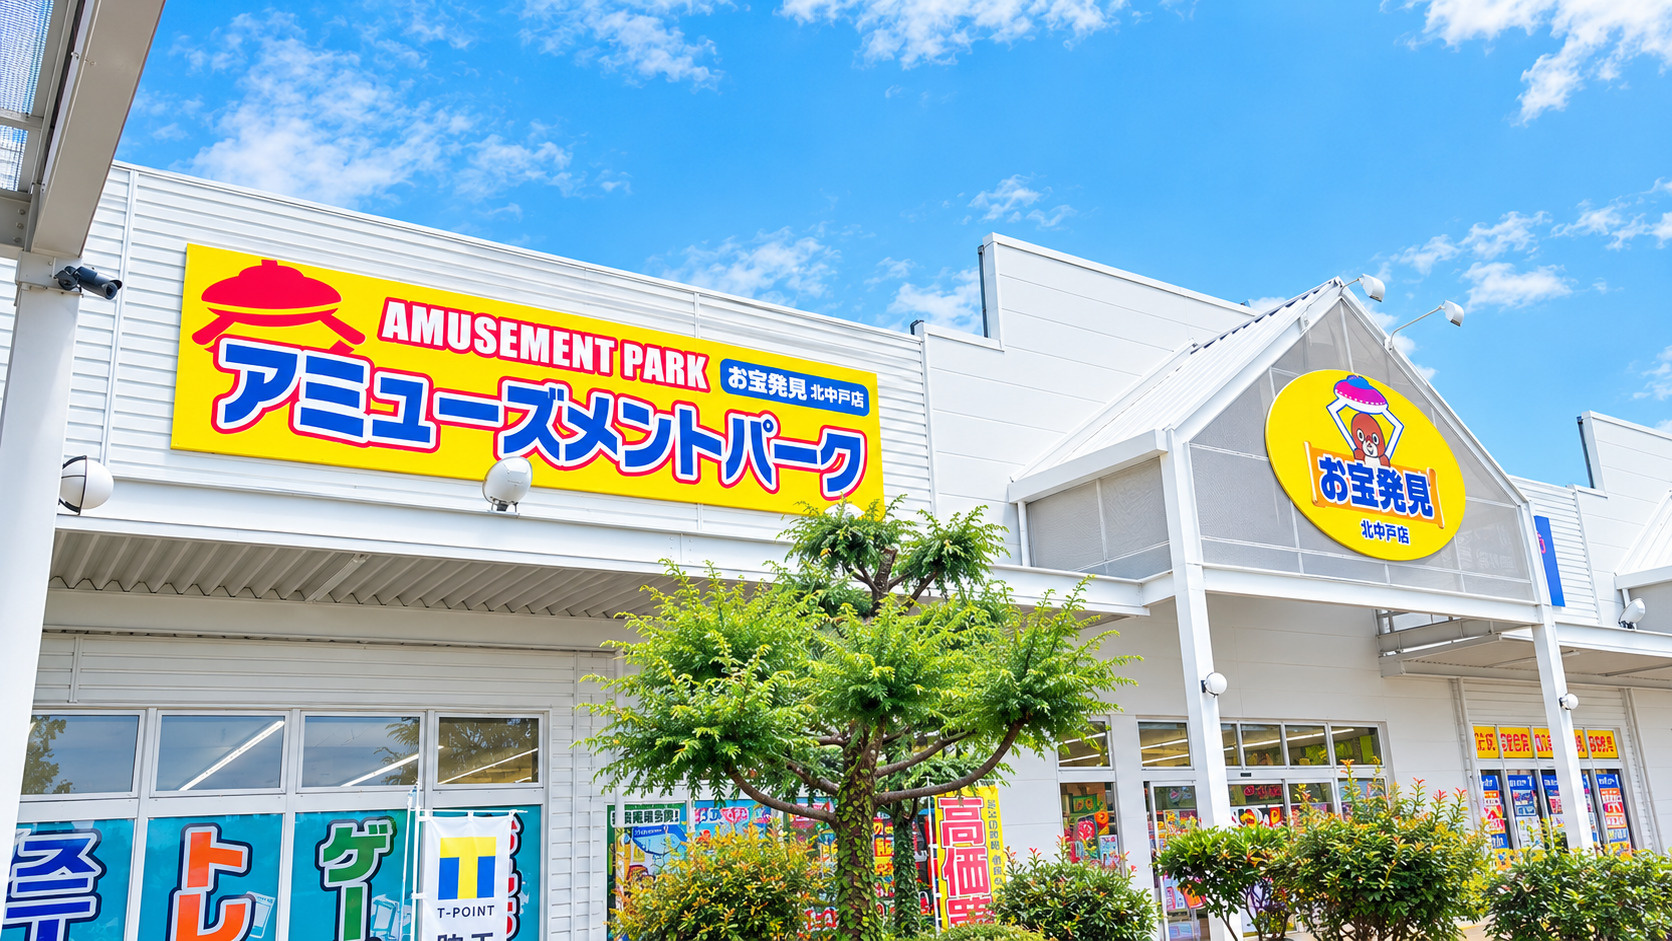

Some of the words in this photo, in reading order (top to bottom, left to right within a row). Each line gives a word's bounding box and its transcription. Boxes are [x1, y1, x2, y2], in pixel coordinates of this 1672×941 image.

[381, 300, 615, 376] AMUSEMENT
[622, 342, 708, 389] PARK
[728, 366, 807, 401] お宝発見
[810, 384, 864, 409] 北中戸店
[219, 341, 868, 495] アミューズメントパーク
[1319, 456, 1434, 518] お宝発見
[1360, 520, 1410, 544] 北中戸店
[437, 905, 495, 919] T-POINT
